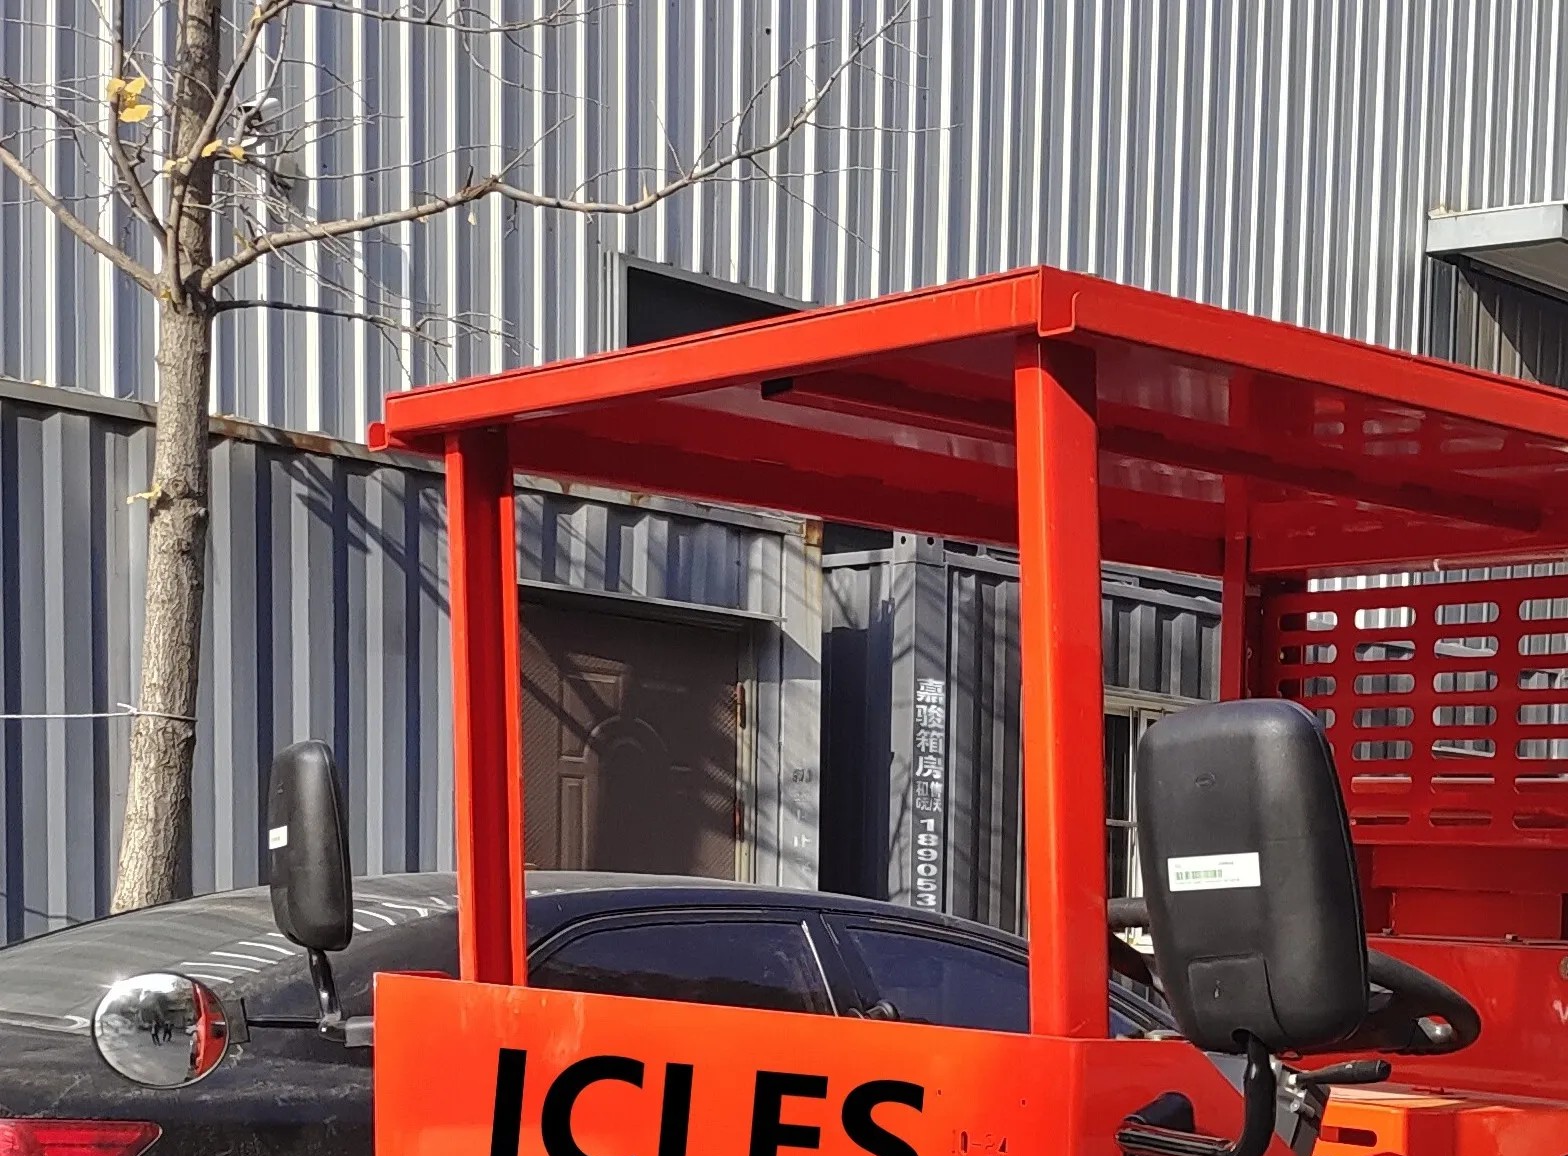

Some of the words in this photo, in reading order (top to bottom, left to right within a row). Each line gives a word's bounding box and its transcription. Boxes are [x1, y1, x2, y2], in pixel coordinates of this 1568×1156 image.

[915, 678, 945, 779] 嘉骏箱房
[916, 818, 939, 913] 189053
